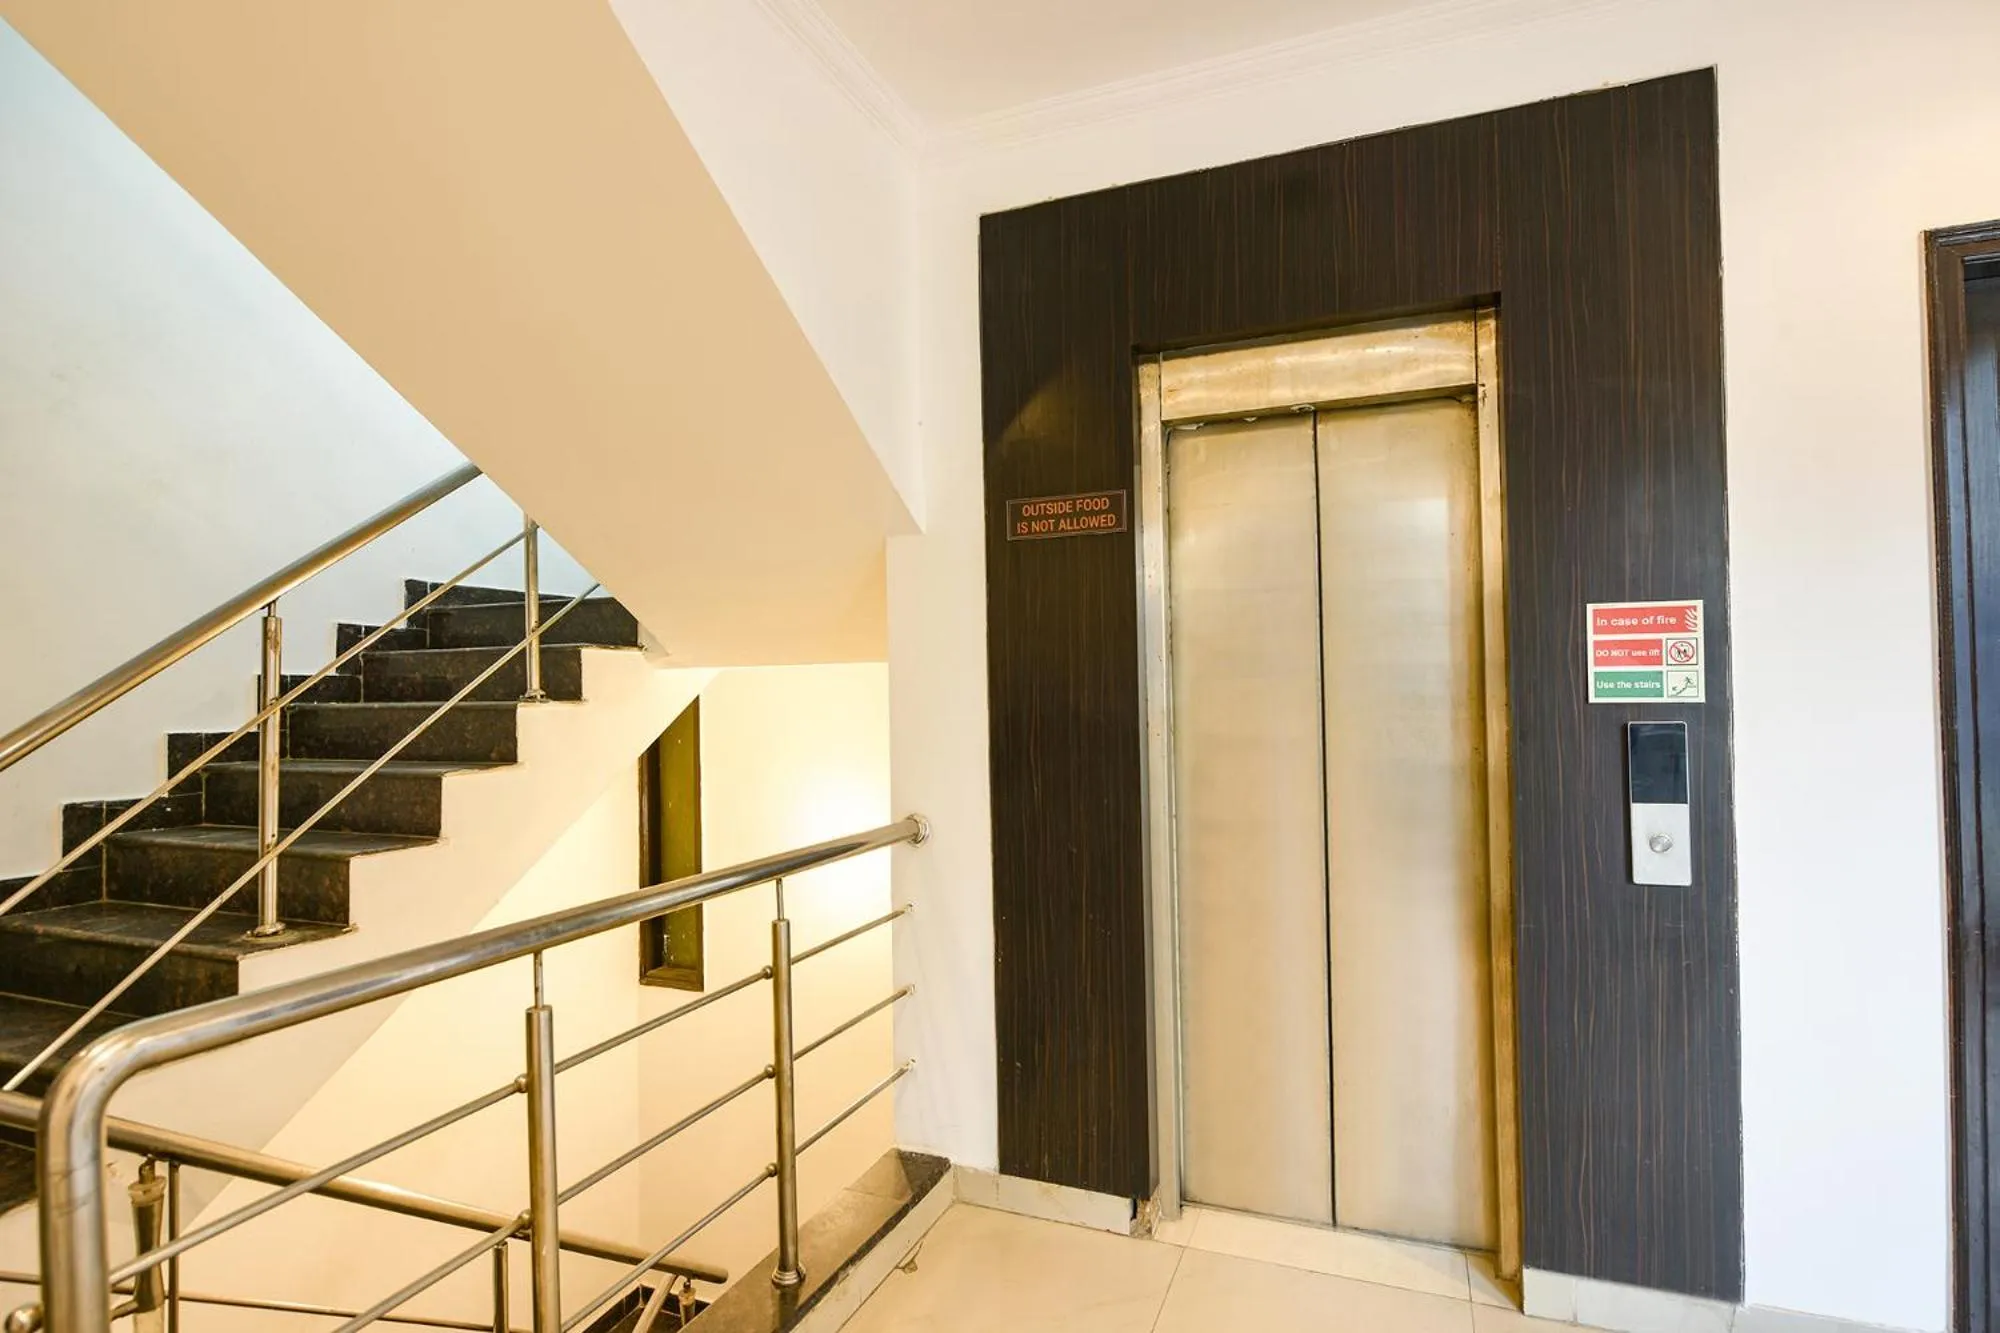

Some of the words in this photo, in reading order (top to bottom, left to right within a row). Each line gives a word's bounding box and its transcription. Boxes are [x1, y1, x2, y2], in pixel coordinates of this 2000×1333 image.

[1022, 500, 1073, 517] OUTSIDE
[1076, 497, 1110, 512] FOOD
[1016, 522, 1029, 534] IS
[1031, 519, 1055, 533] NOT
[1058, 513, 1116, 531] ALLOWED
[1596, 617, 1608, 626] In
[1611, 617, 1638, 626] case
[1641, 615, 1654, 625] of
[1656, 615, 1677, 625] fire
[1595, 649, 1609, 657] DO
[1610, 649, 1629, 657] NOT
[1631, 649, 1647, 657] use
[1596, 680, 1616, 689] Use
[1617, 680, 1632, 689] the
[1633, 679, 1661, 689] stairs
